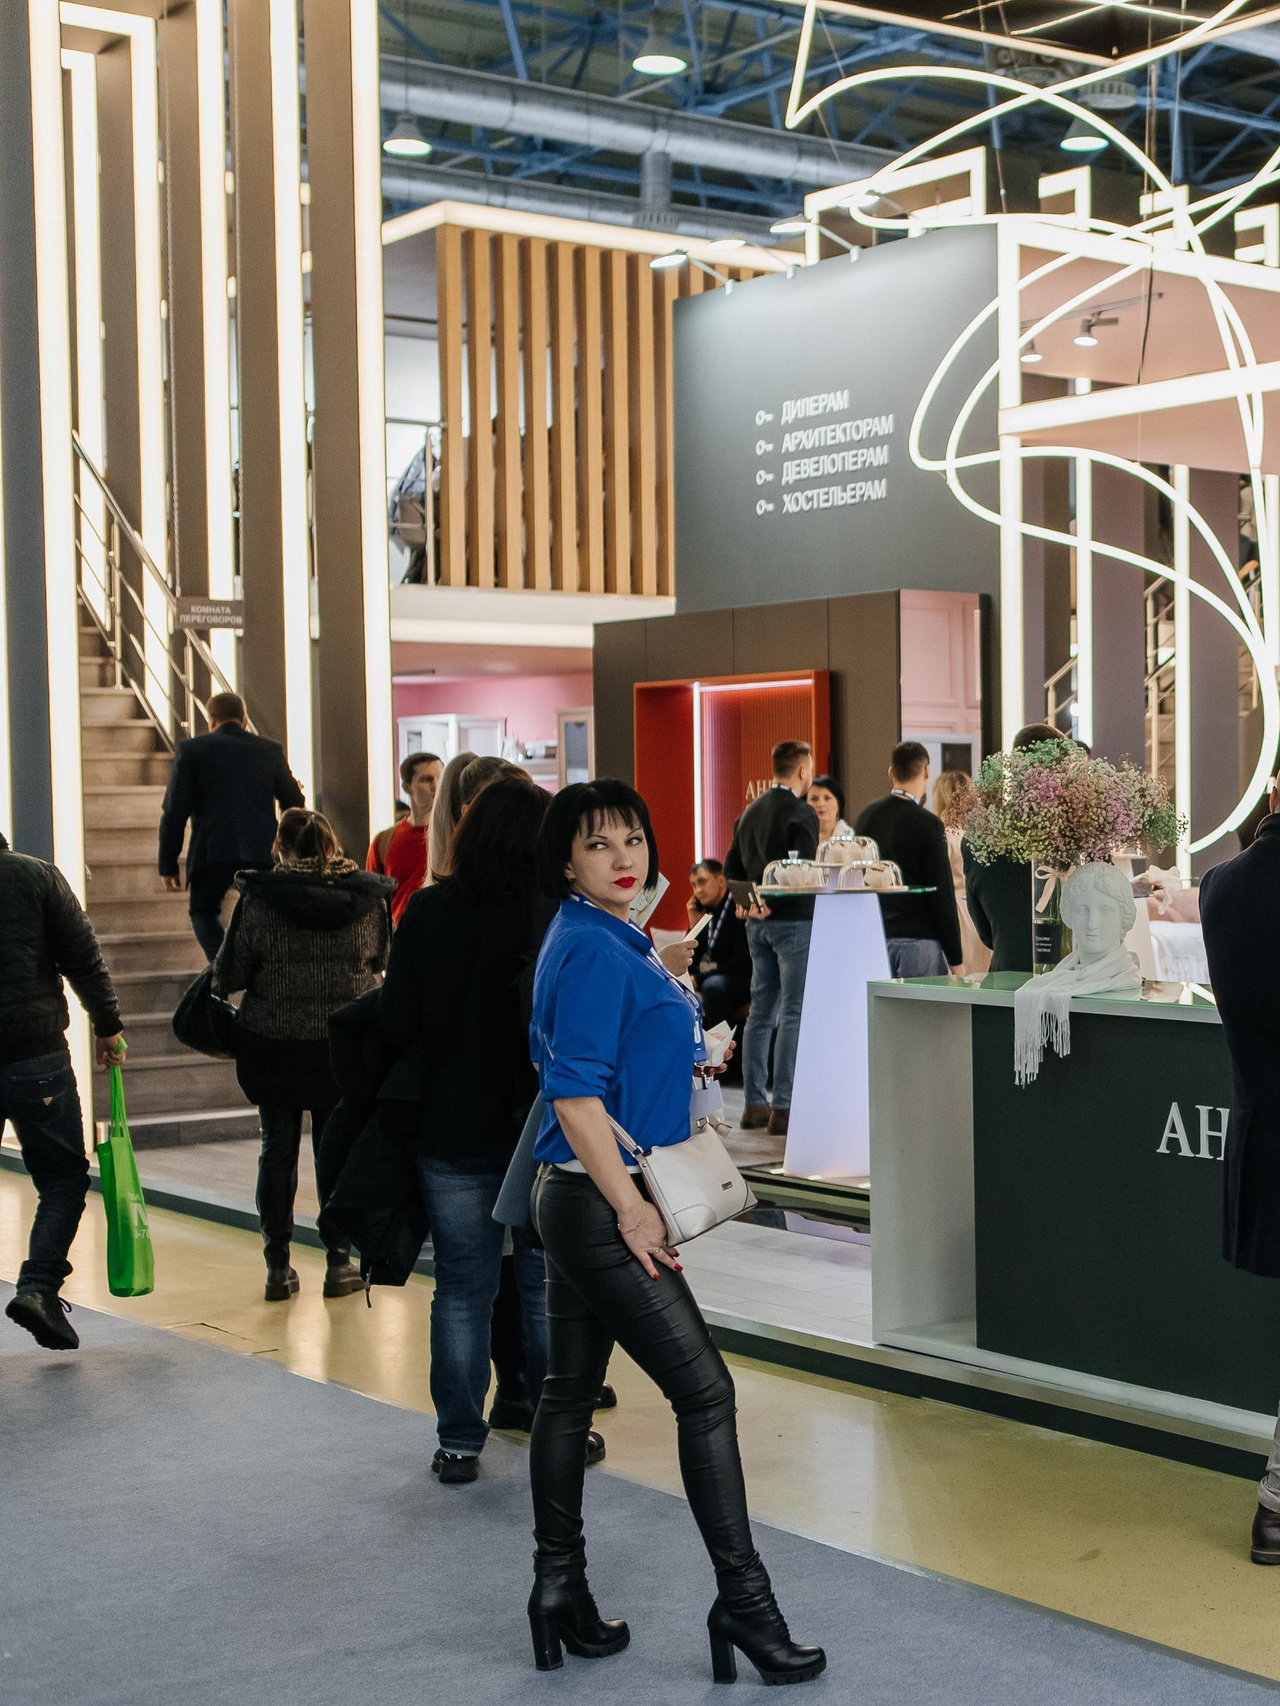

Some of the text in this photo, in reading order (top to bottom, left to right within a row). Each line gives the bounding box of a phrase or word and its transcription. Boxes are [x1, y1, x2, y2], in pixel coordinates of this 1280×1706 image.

[781, 389, 849, 425] ДИЛЕРАМ
[781, 414, 895, 454] АРХИТЕКТОРАМ
[781, 444, 889, 486] ДЕВЕЛОПЕРАМ
[782, 478, 888, 514] ХОСТЕЛЬЕРАМ
[179, 614, 243, 625] ПЕРЕГОВОРОВ
[190, 605, 232, 615] КОМНАТА
